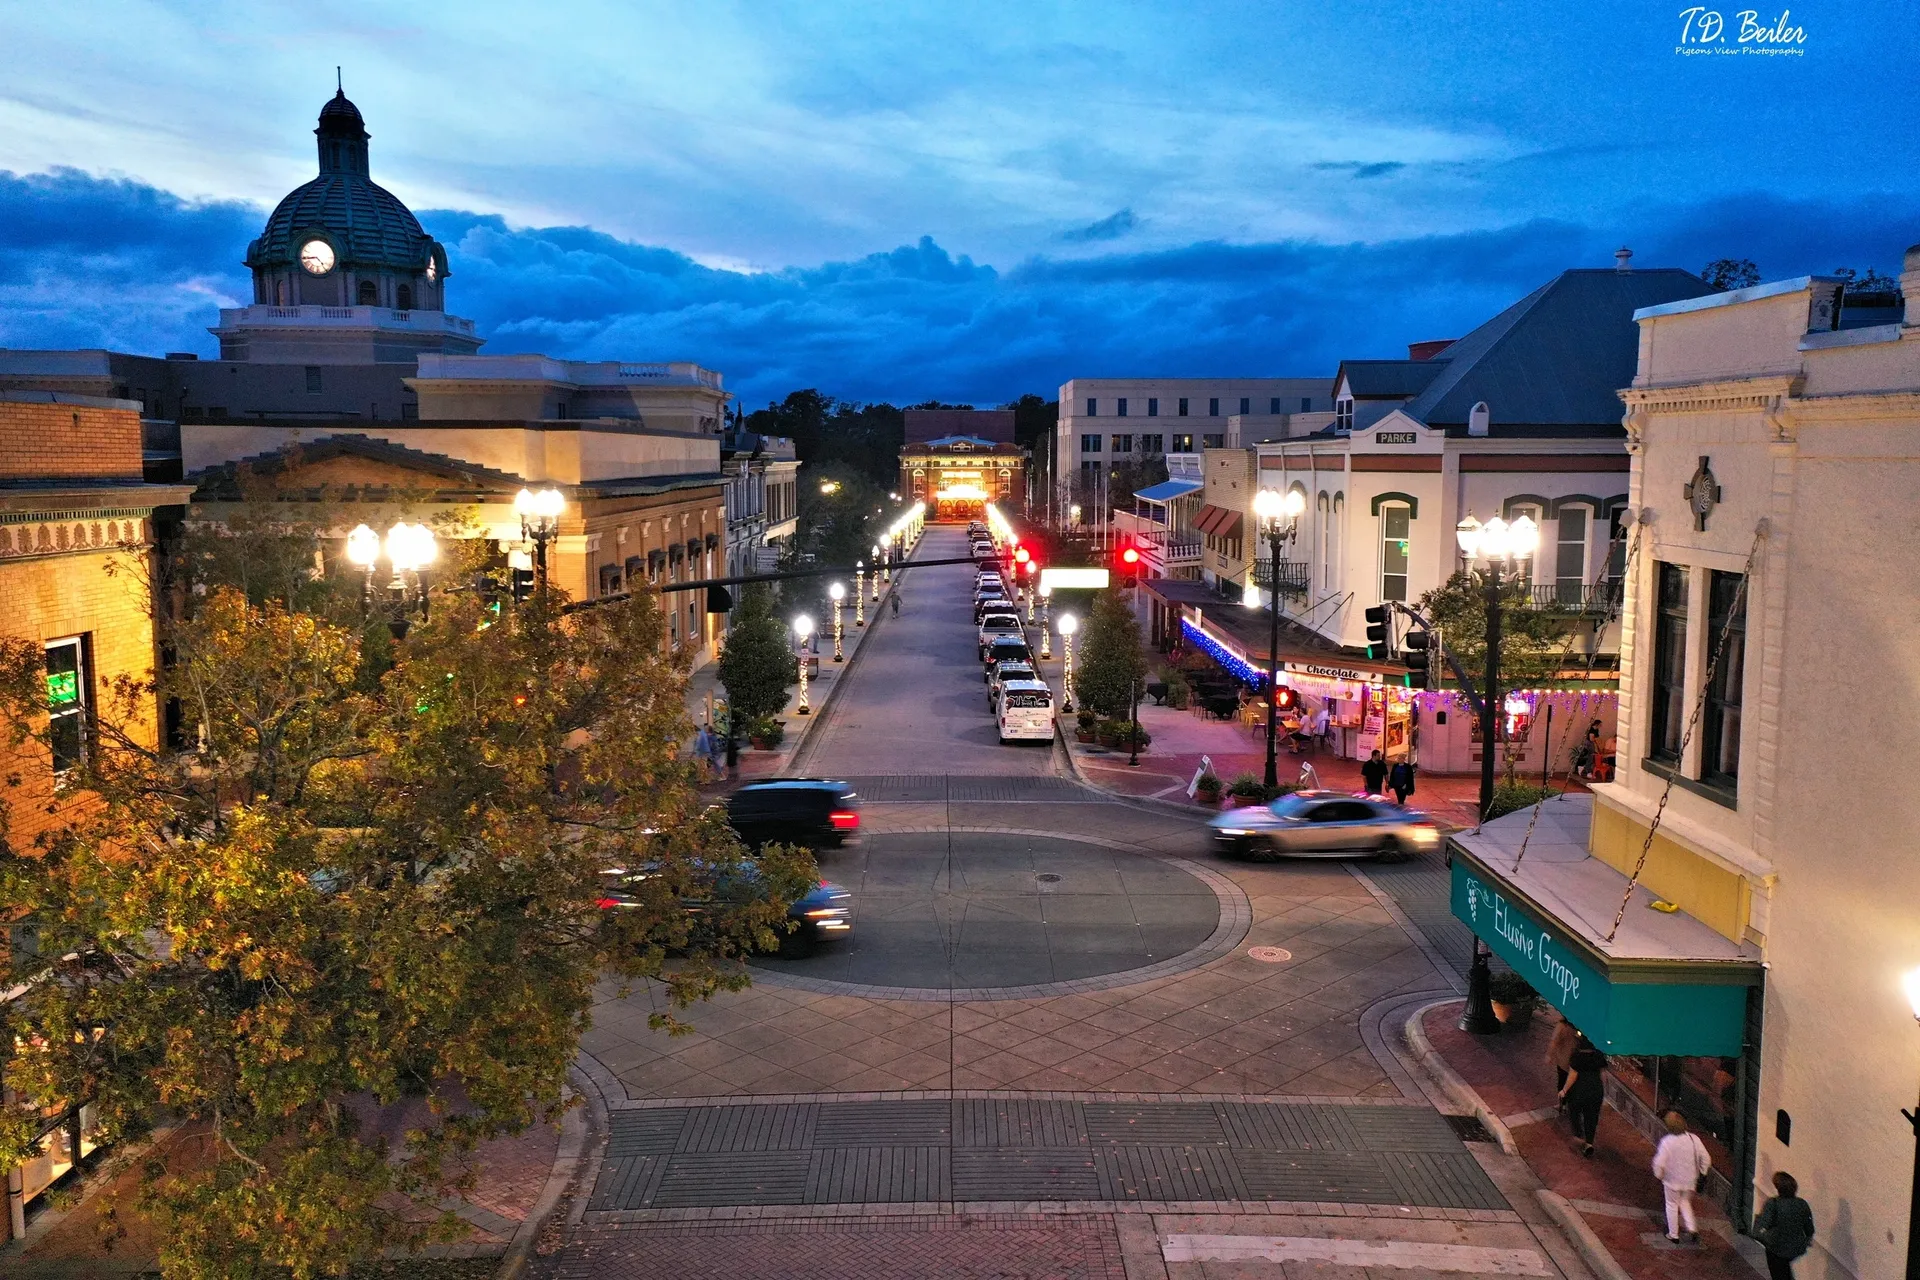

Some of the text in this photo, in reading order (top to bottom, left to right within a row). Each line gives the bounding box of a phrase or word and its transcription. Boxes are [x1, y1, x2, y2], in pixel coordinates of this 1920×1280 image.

[1381, 433, 1413, 443] PARKE
[1306, 664, 1359, 679] Chocolate
[1494, 893, 1580, 1006] Elusive Grape
